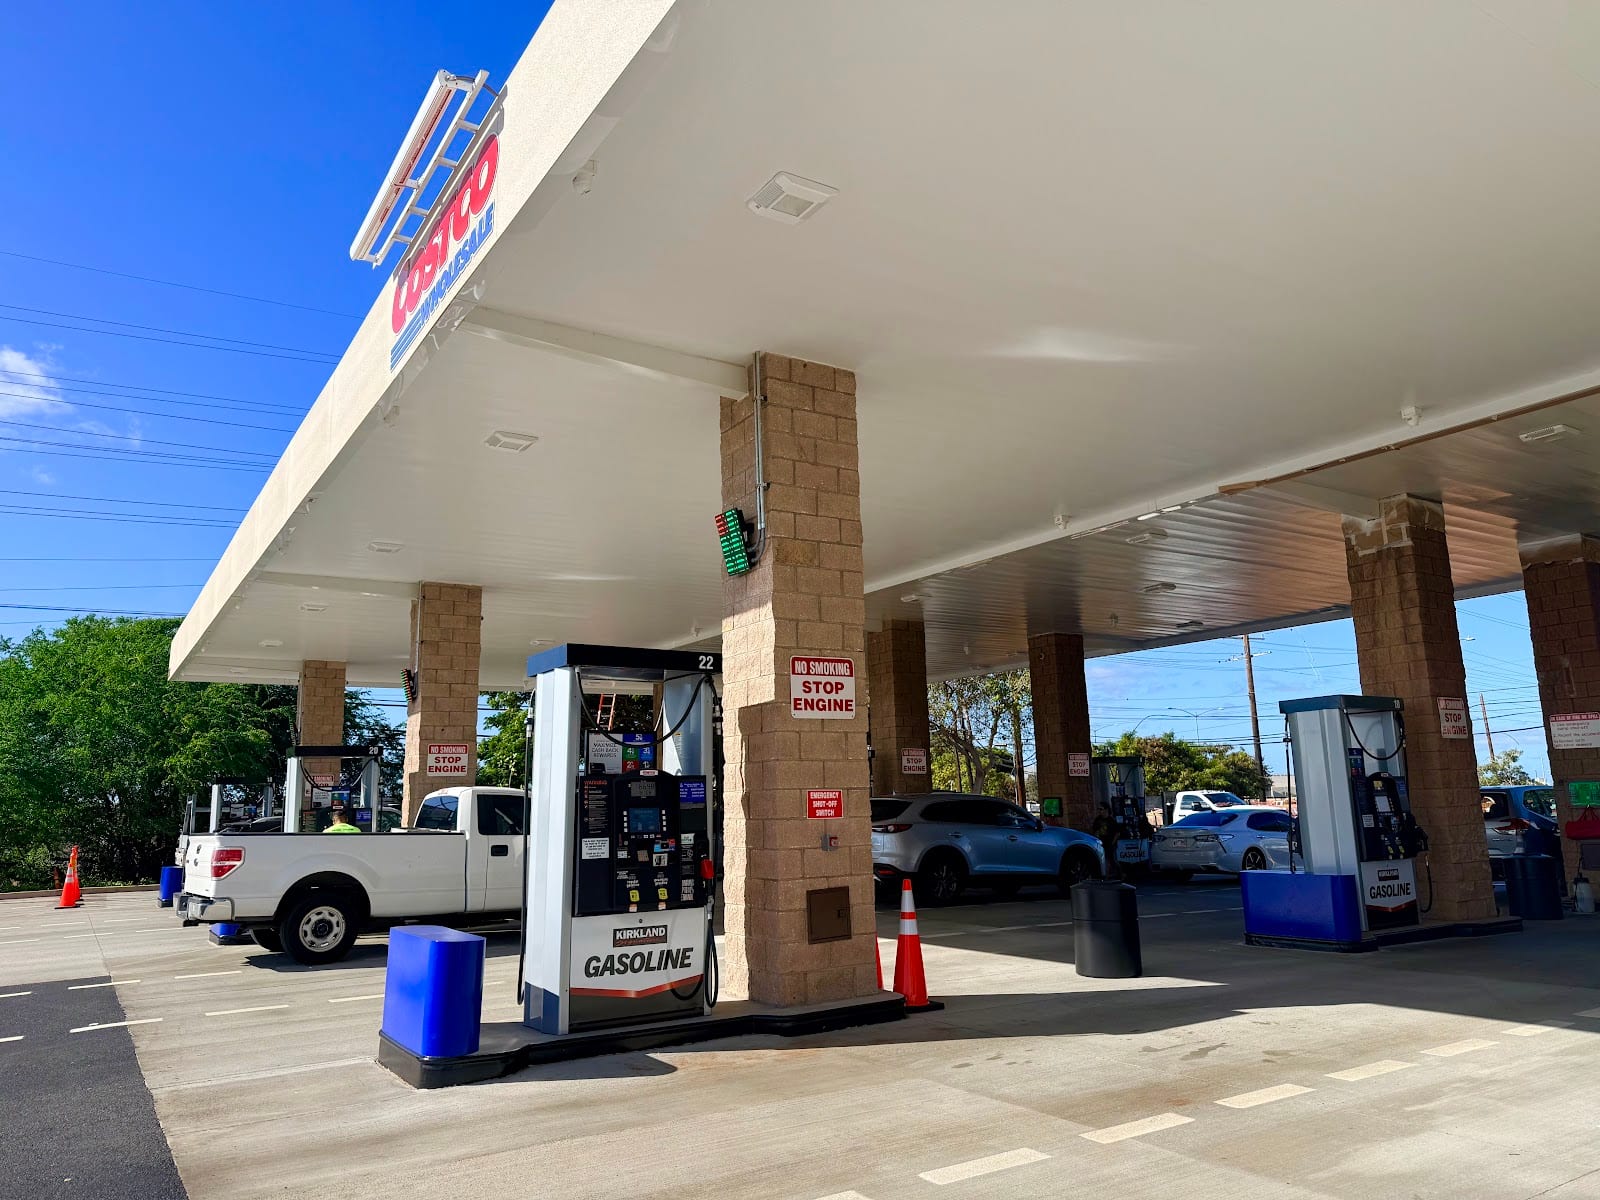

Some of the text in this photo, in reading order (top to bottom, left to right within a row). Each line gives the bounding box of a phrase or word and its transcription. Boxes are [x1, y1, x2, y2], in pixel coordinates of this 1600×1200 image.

[391, 133, 499, 335] COSTCO
[419, 201, 495, 324] WHOLESALE
[698, 655, 714, 670] 22
[795, 660, 851, 676] NO SMOKING
[802, 680, 845, 694] STOP
[793, 697, 854, 712] ENGINE
[1444, 712, 1462, 723] STOP
[1442, 725, 1467, 735] ENGINE
[368, 746, 379, 755] 20
[430, 746, 466, 754] NO SMOKING
[434, 756, 462, 764] STOP
[428, 765, 467, 773] ENGINE
[810, 791, 839, 799] EMERGENCY
[812, 800, 838, 808] SHUT-OFF
[815, 809, 835, 817] SWITCH
[1369, 882, 1411, 899] GASOLINE
[616, 927, 666, 939] KIRKLAND
[584, 947, 693, 978] GASOLINE
